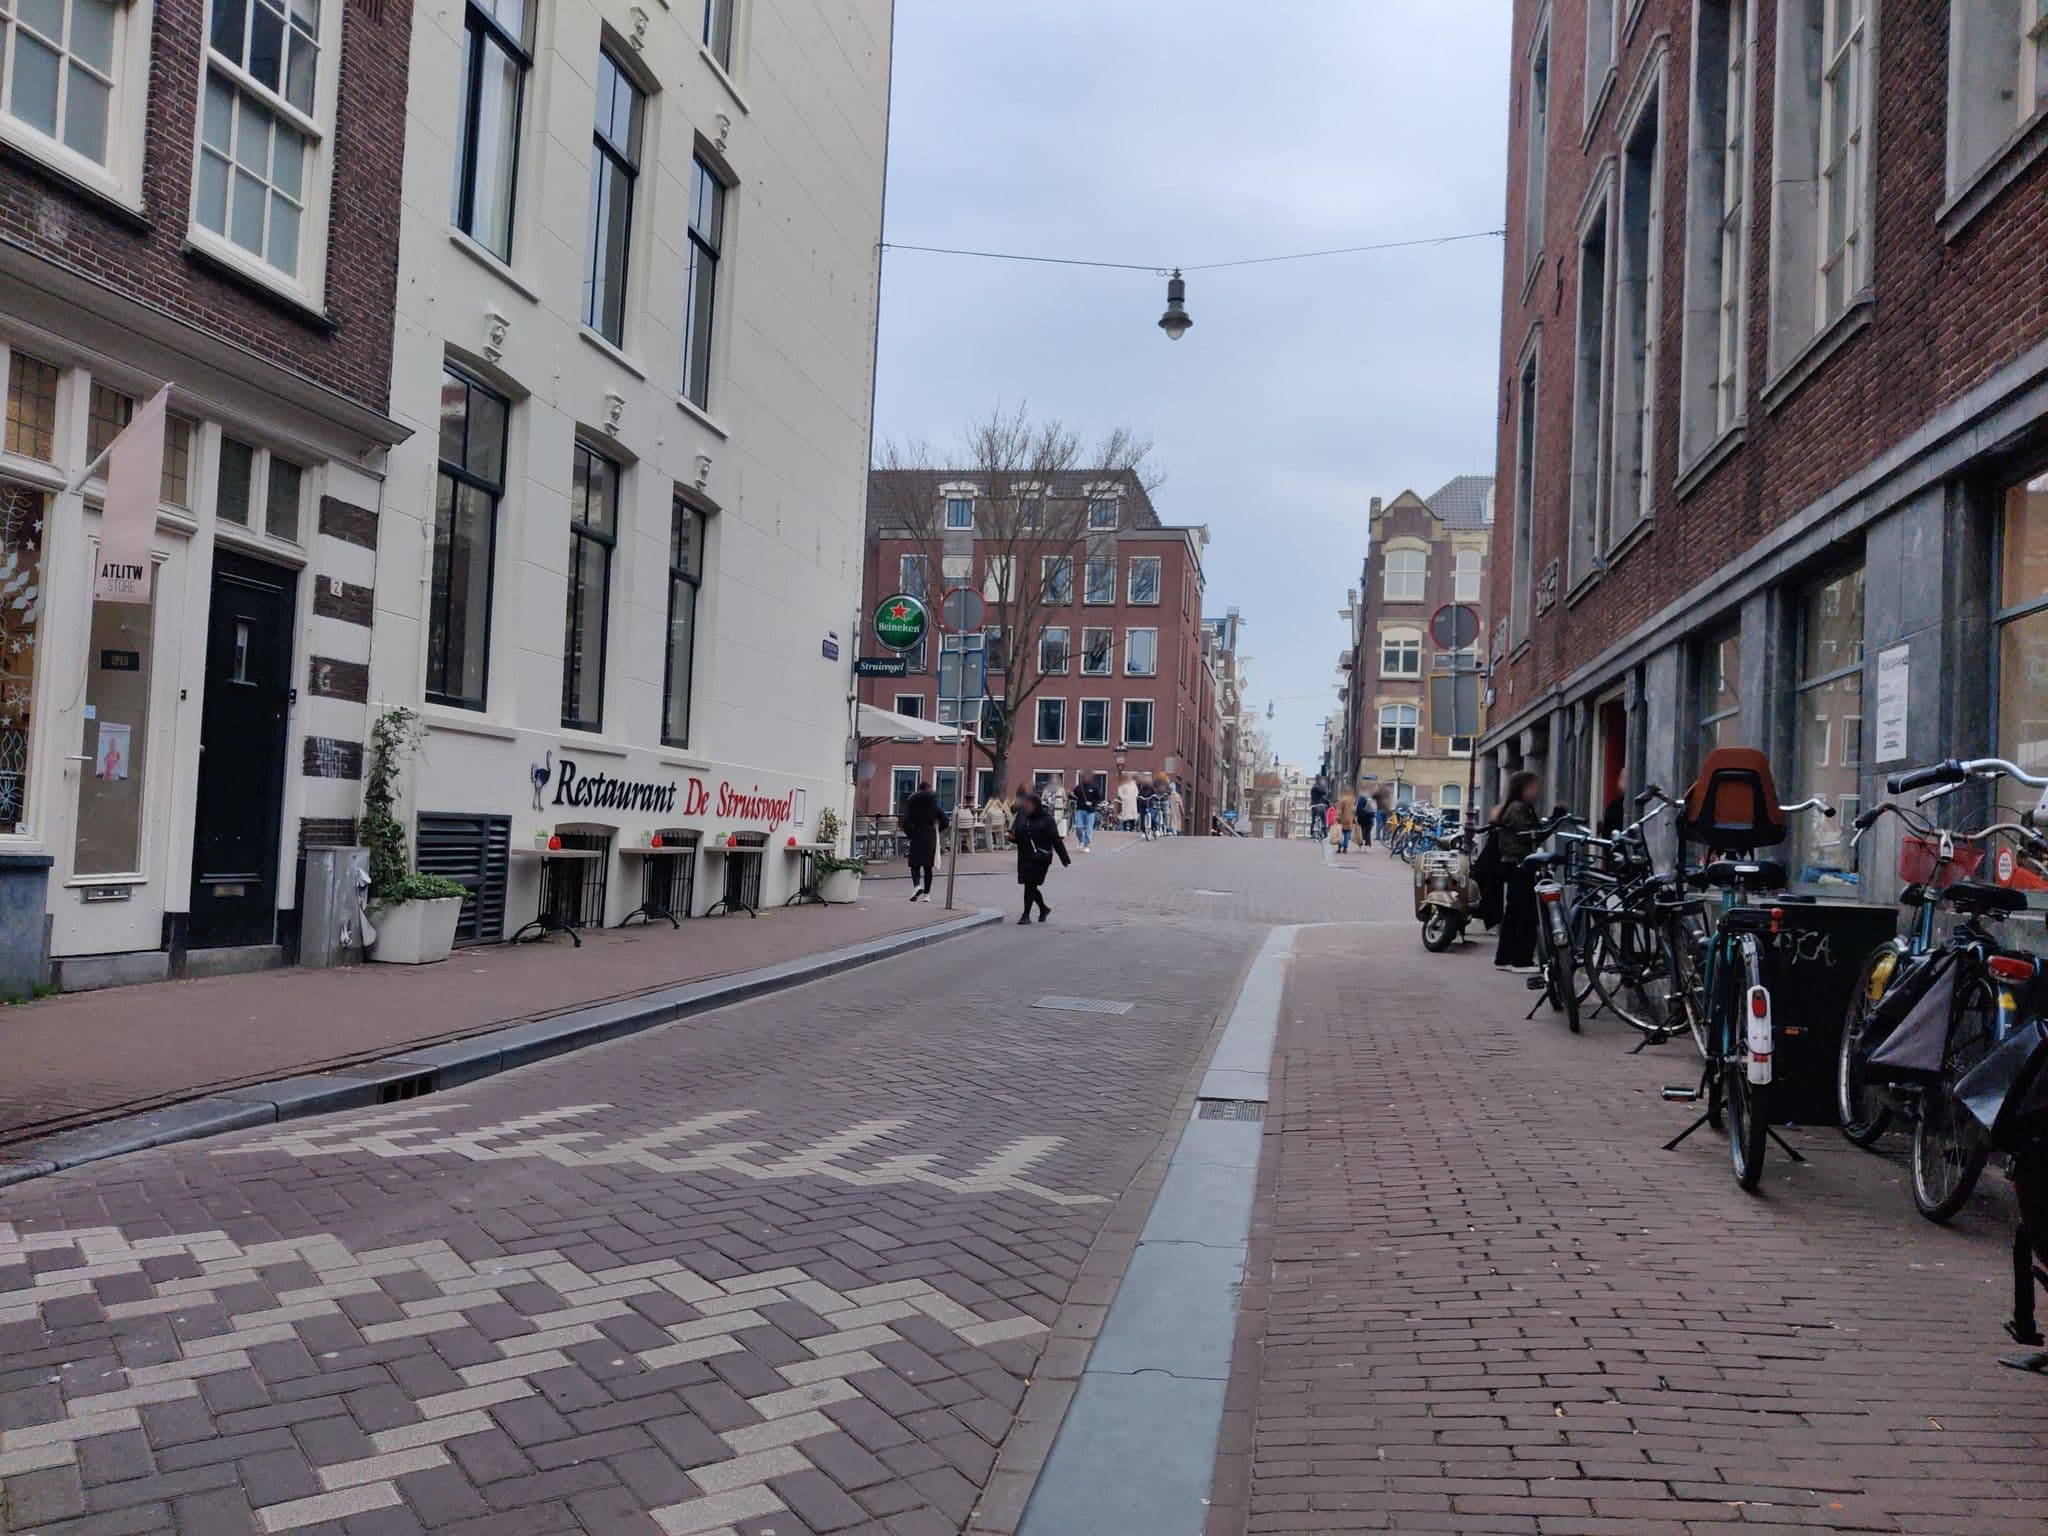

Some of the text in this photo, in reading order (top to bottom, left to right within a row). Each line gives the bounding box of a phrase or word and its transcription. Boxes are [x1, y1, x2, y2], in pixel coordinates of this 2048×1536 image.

[101, 563, 143, 580] ATLITW
[107, 579, 136, 593] STORE
[333, 581, 341, 595] 2
[878, 622, 920, 633] Heineken
[859, 661, 905, 674] Struisvogel
[552, 759, 794, 833] Restaurant De Struisvogel
